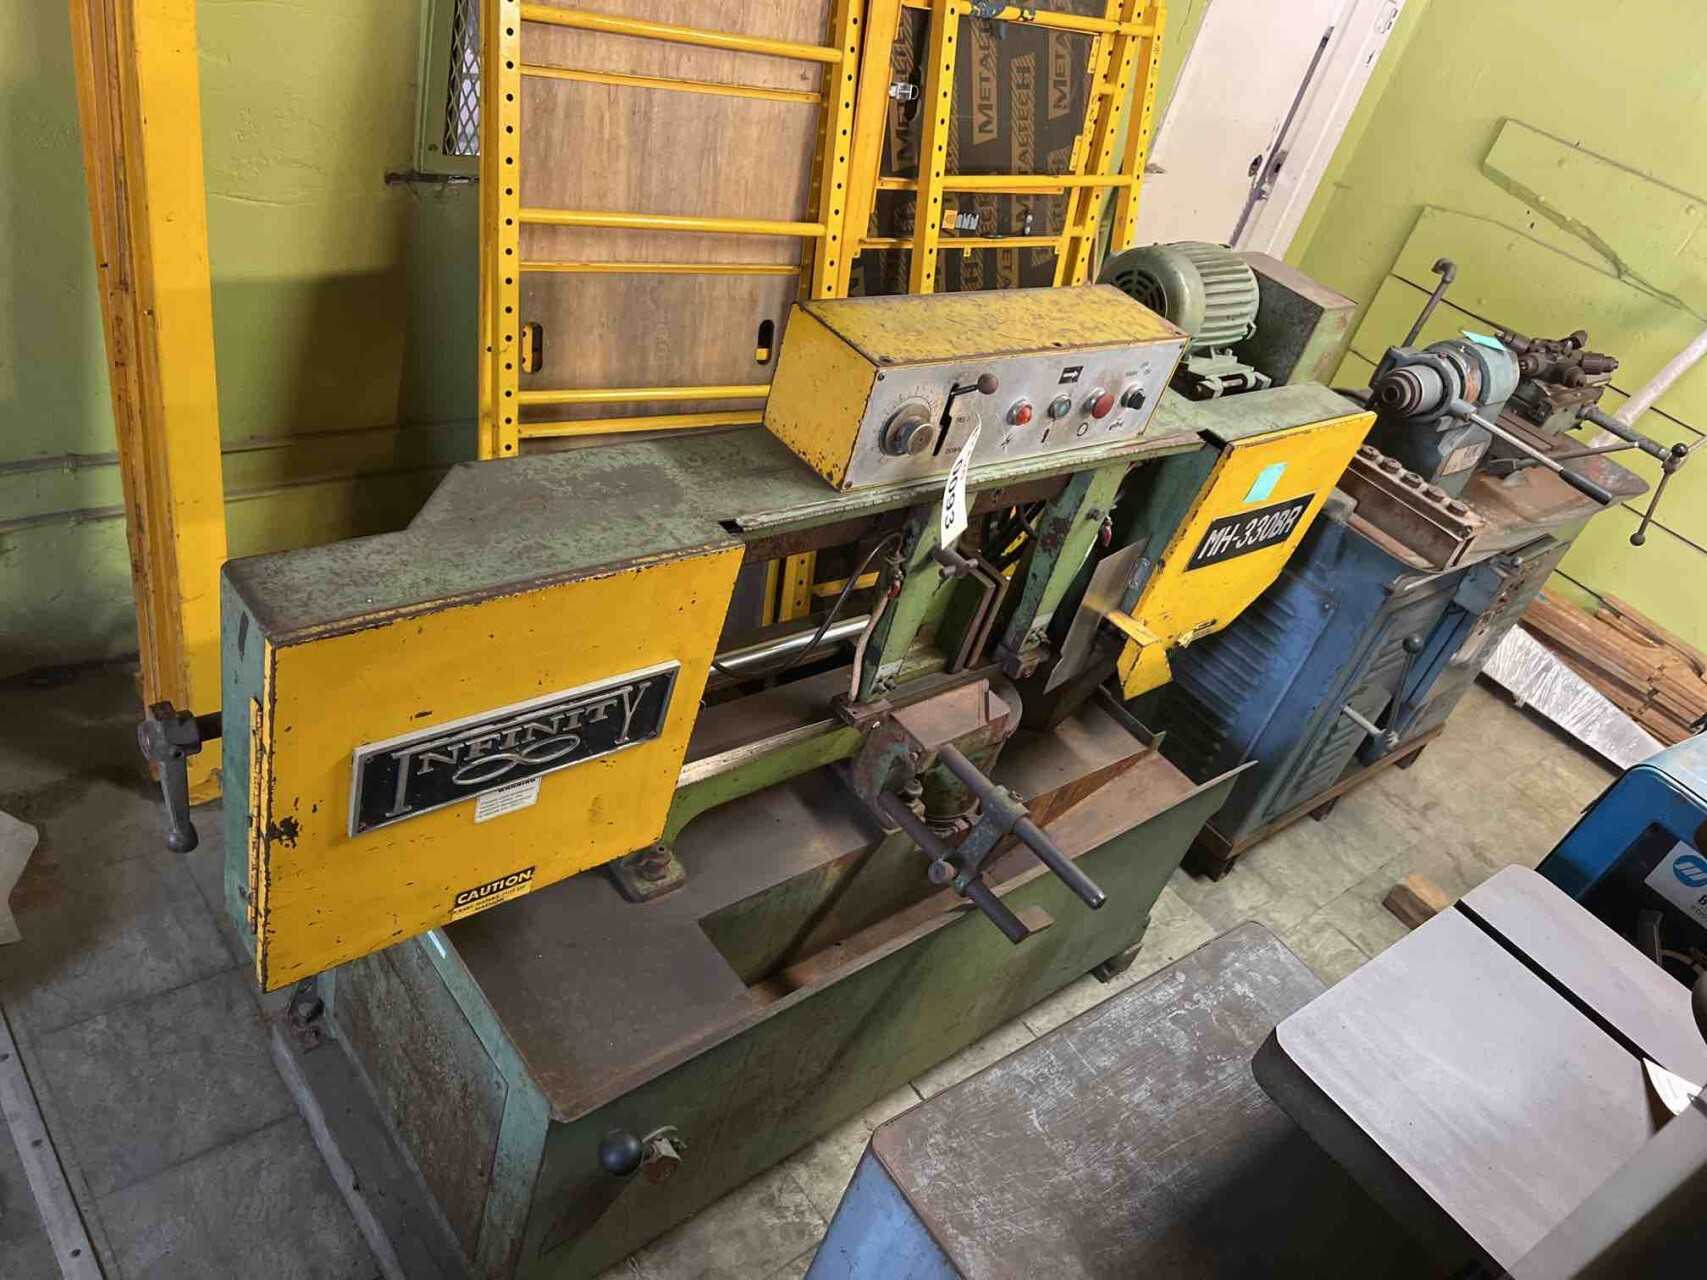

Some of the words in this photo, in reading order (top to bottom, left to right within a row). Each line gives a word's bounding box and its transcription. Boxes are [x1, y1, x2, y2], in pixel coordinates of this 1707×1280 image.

[945, 458, 963, 529] 0093
[1197, 506, 1304, 560] MH-330BR
[385, 681, 652, 818] INFINITY
[457, 870, 532, 904] CAUTION
